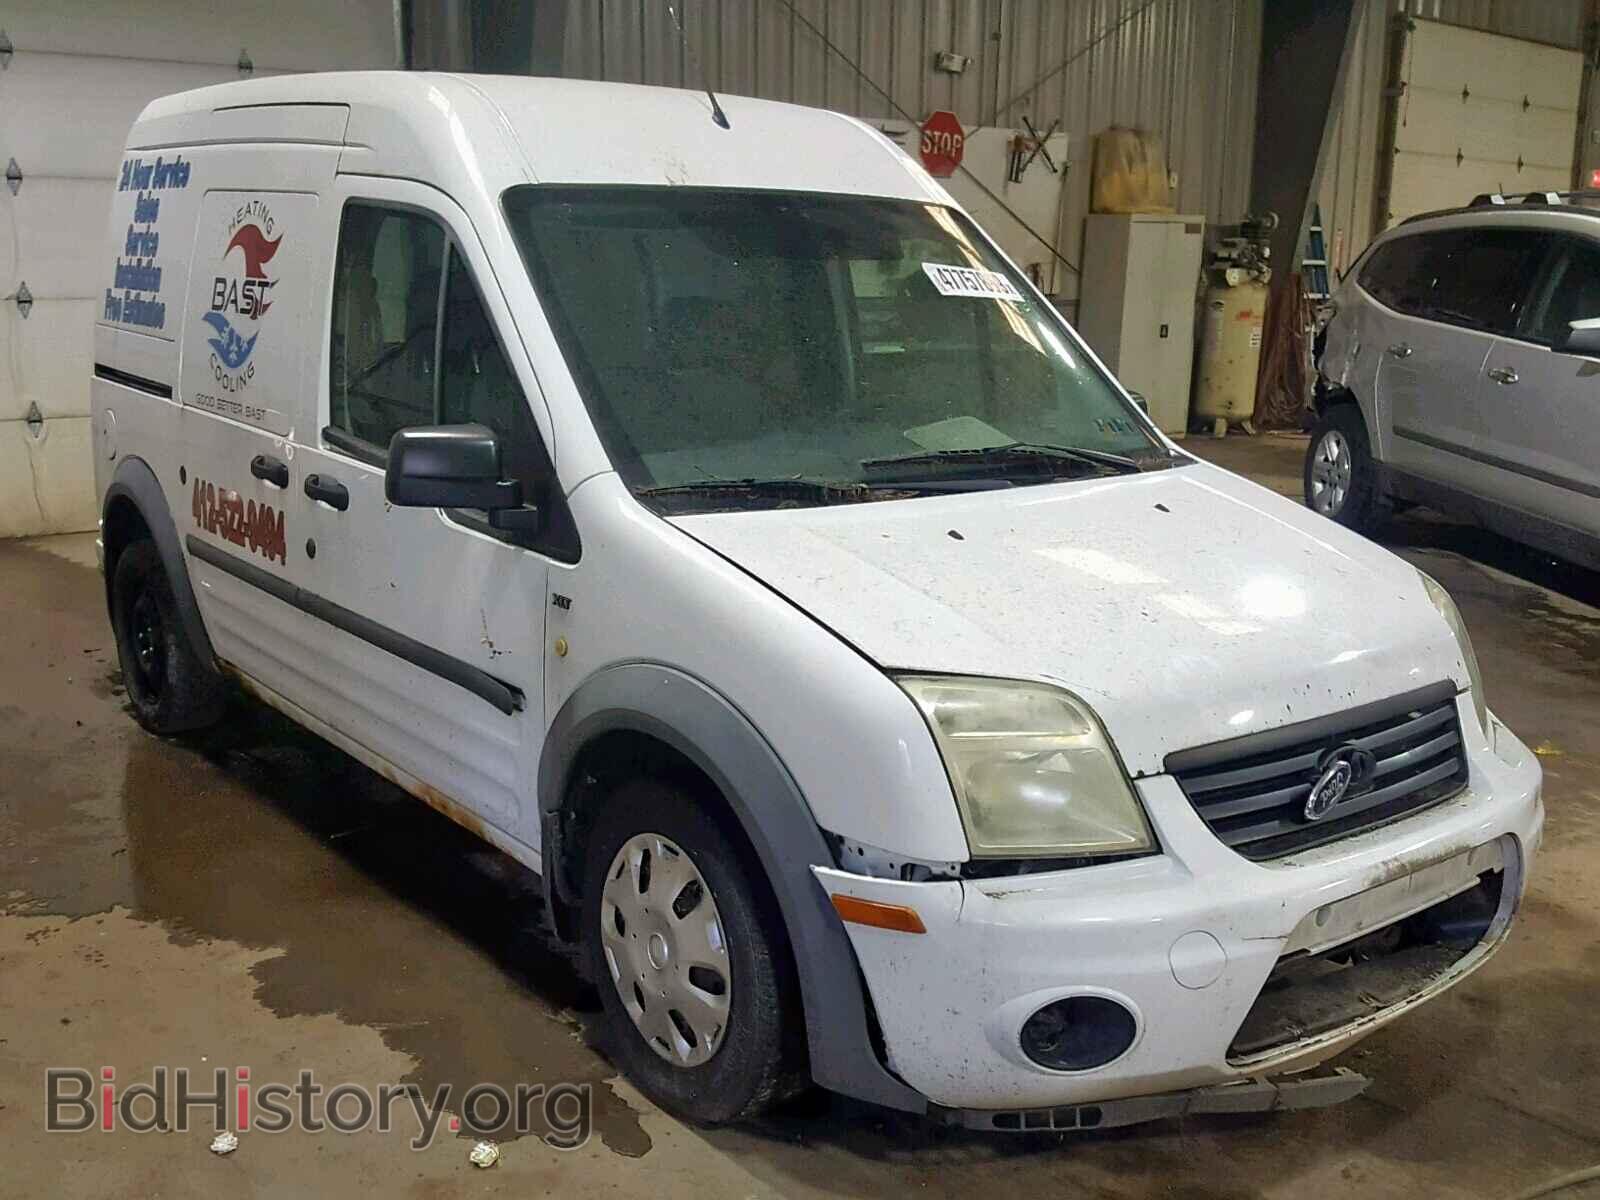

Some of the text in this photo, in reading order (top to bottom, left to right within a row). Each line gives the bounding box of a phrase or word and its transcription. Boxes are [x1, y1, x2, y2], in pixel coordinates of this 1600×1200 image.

[921, 130, 962, 157] STOP
[152, 154, 190, 190] Service
[228, 200, 275, 235] HEATING
[125, 223, 160, 257] Service
[211, 277, 273, 316] BAST
[936, 267, 1011, 294] 47757
[209, 353, 256, 393] COOLING
